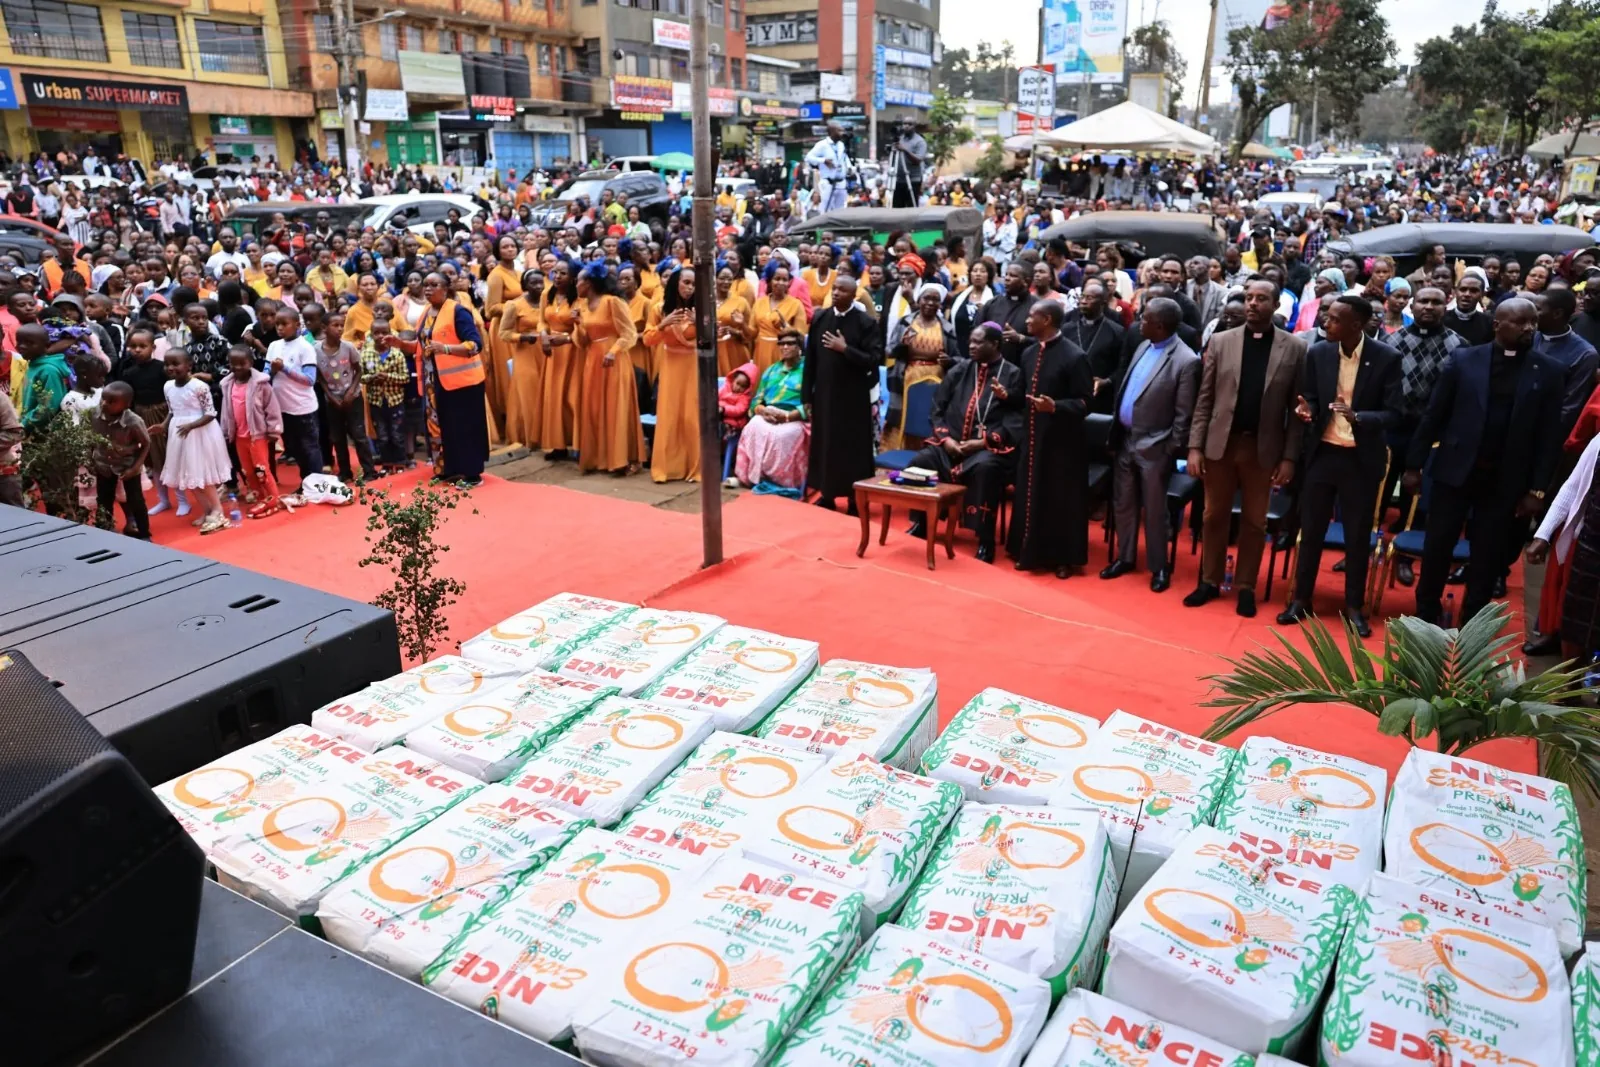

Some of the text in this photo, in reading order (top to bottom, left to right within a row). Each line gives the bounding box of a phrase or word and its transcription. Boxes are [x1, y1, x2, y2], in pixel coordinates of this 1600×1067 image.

[746, 24, 794, 41] GYM
[33, 82, 180, 105] Urban SUPERMARKET
[564, 658, 626, 679] NICE
[684, 672, 741, 689] PREMIUM
[660, 686, 729, 708] NICE
[796, 708, 860, 724] PREMIUM
[302, 733, 367, 764] NICE
[774, 724, 850, 746] NICE
[1137, 723, 1217, 757] NICE
[394, 759, 464, 793] NICE
[548, 757, 609, 777] PREMIUM
[950, 753, 1032, 788] NICE
[1451, 761, 1548, 801] NICE
[516, 775, 593, 807] NICE
[848, 775, 917, 801] PREMIUM
[1426, 767, 1498, 798] Extra
[656, 806, 725, 828] PREMIUM
[473, 816, 537, 849] PREMIUM
[614, 839, 635, 852] 2kg
[626, 825, 709, 856] NICE
[647, 851, 662, 859] 12
[1240, 831, 1333, 870] NICE
[250, 852, 290, 881] 12 X 2kg
[791, 852, 846, 879] 12 X 2kg
[466, 888, 487, 900] Nice
[739, 873, 838, 910] NICE
[945, 887, 1030, 904] PREMIUM
[360, 907, 405, 940] 12 X 2kg
[1419, 893, 1491, 927] 12 X 2kg
[925, 910, 1026, 941] NICE
[1210, 918, 1299, 961] Ji Nice Na Nice
[927, 941, 989, 971] 12 X 2kg
[1167, 946, 1236, 985] 12 X 2kg
[451, 951, 548, 1006] NICE
[691, 978, 703, 987] Ji
[732, 987, 750, 998] Na
[753, 991, 780, 1004] Nice
[857, 983, 880, 991] Nice
[884, 986, 900, 995] Na
[632, 1020, 699, 1059] 12 X 2kg
